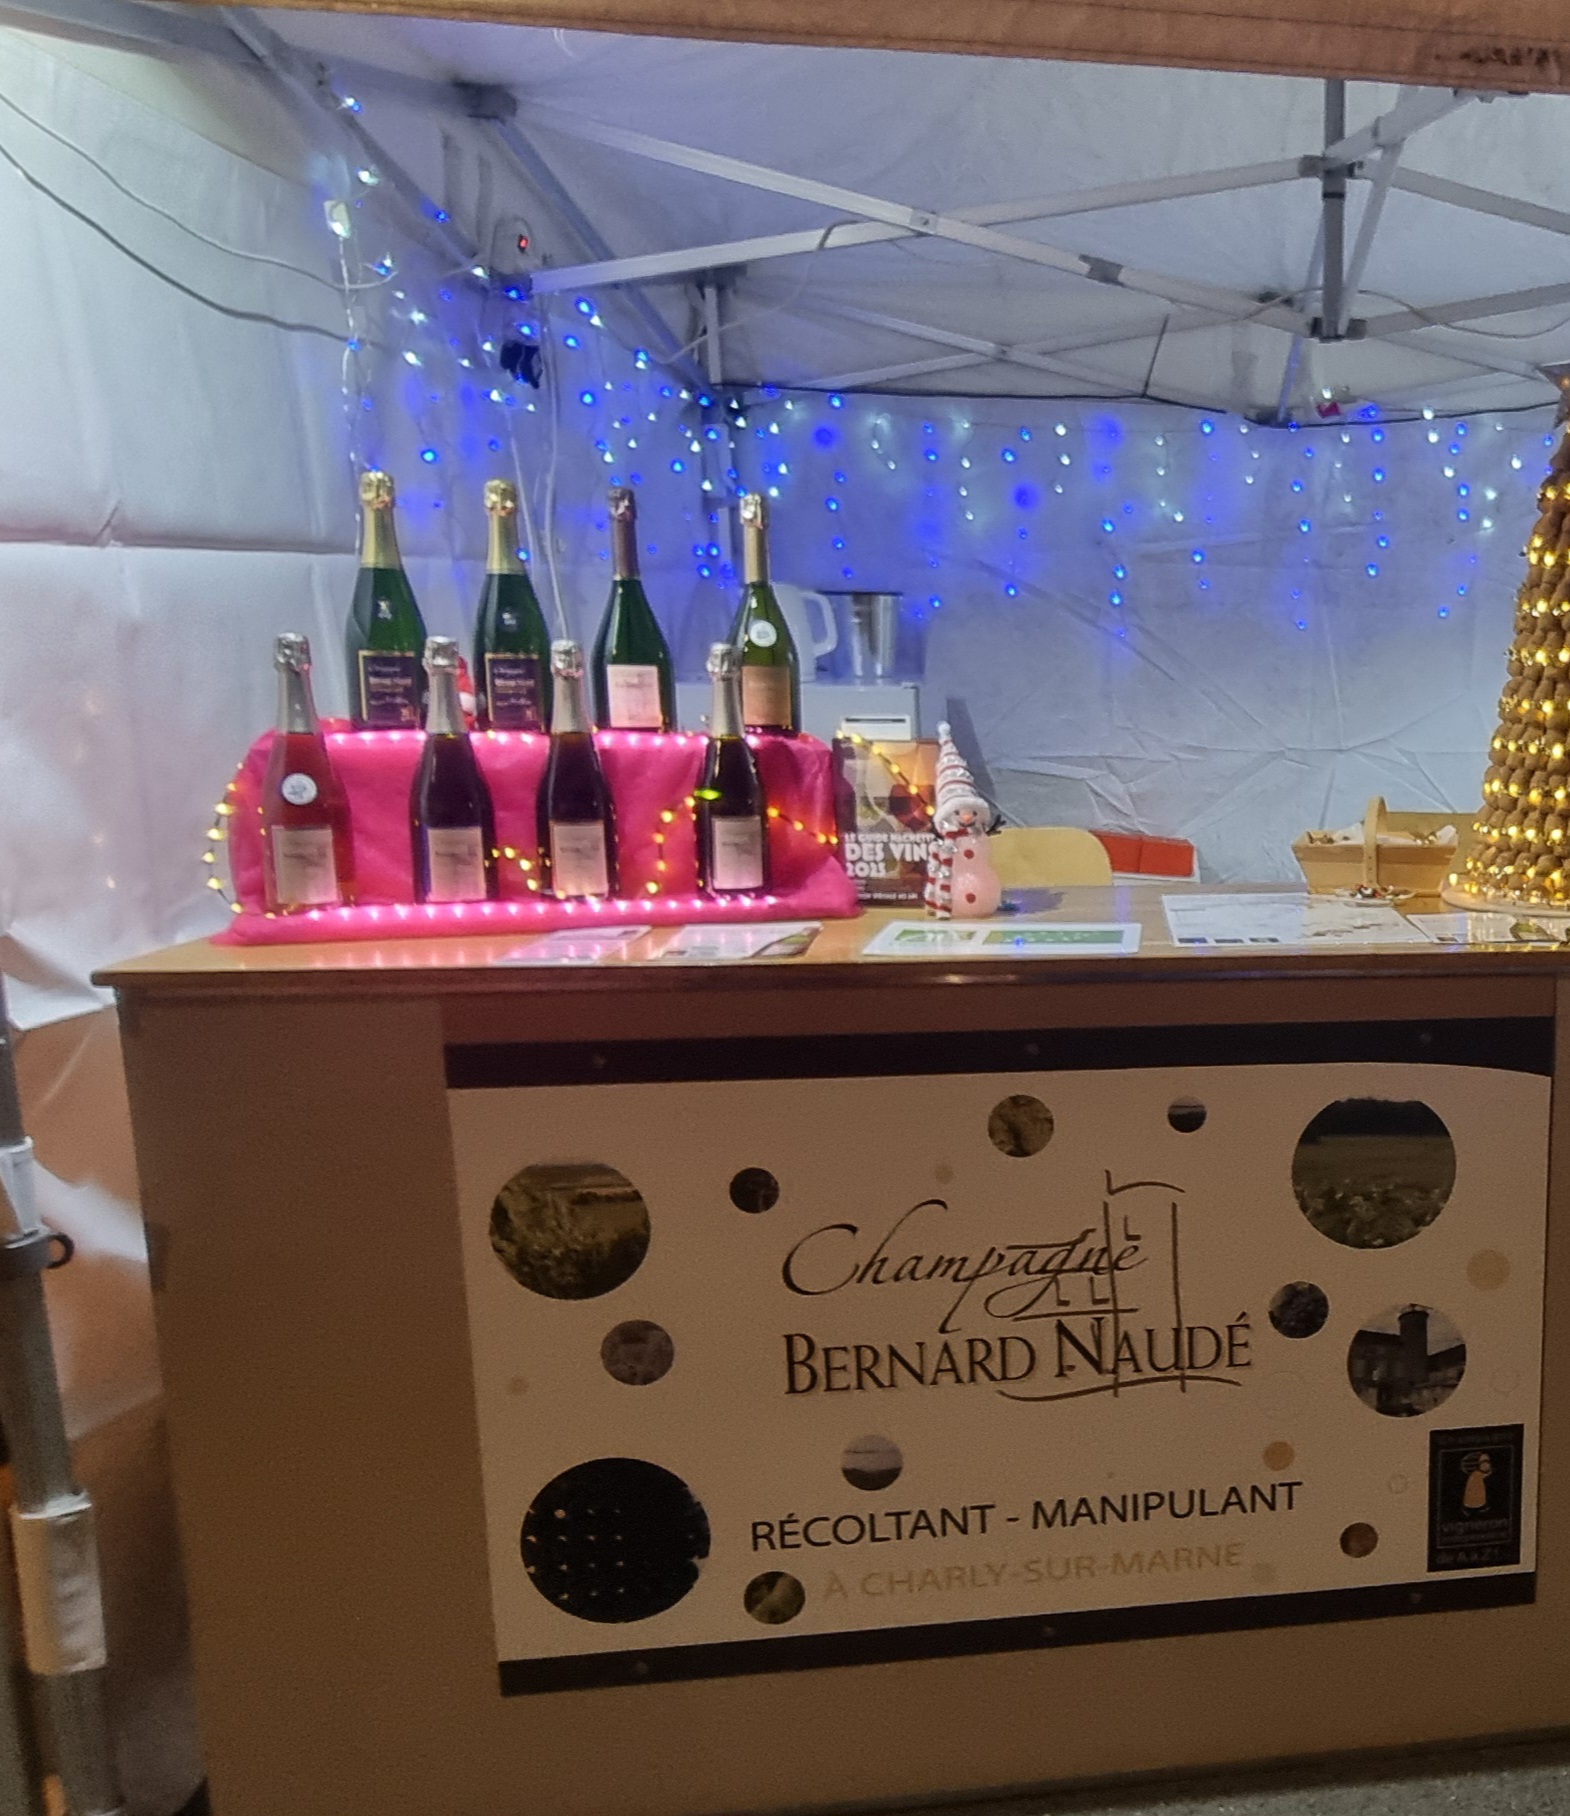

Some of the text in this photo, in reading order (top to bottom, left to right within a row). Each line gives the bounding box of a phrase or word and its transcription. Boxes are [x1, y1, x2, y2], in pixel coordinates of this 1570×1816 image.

[844, 843, 929, 863] DES VIN
[890, 832, 936, 843] HACHETT
[782, 1199, 1148, 1334] Champagne
[783, 1311, 1252, 1395] BERNARD NAUDÉ
[751, 1504, 996, 1552] RÉCOLTANT
[1031, 1481, 1303, 1531] MANIPULANT
[823, 1542, 1243, 1600] À CHARLY-SUR-MARNE
